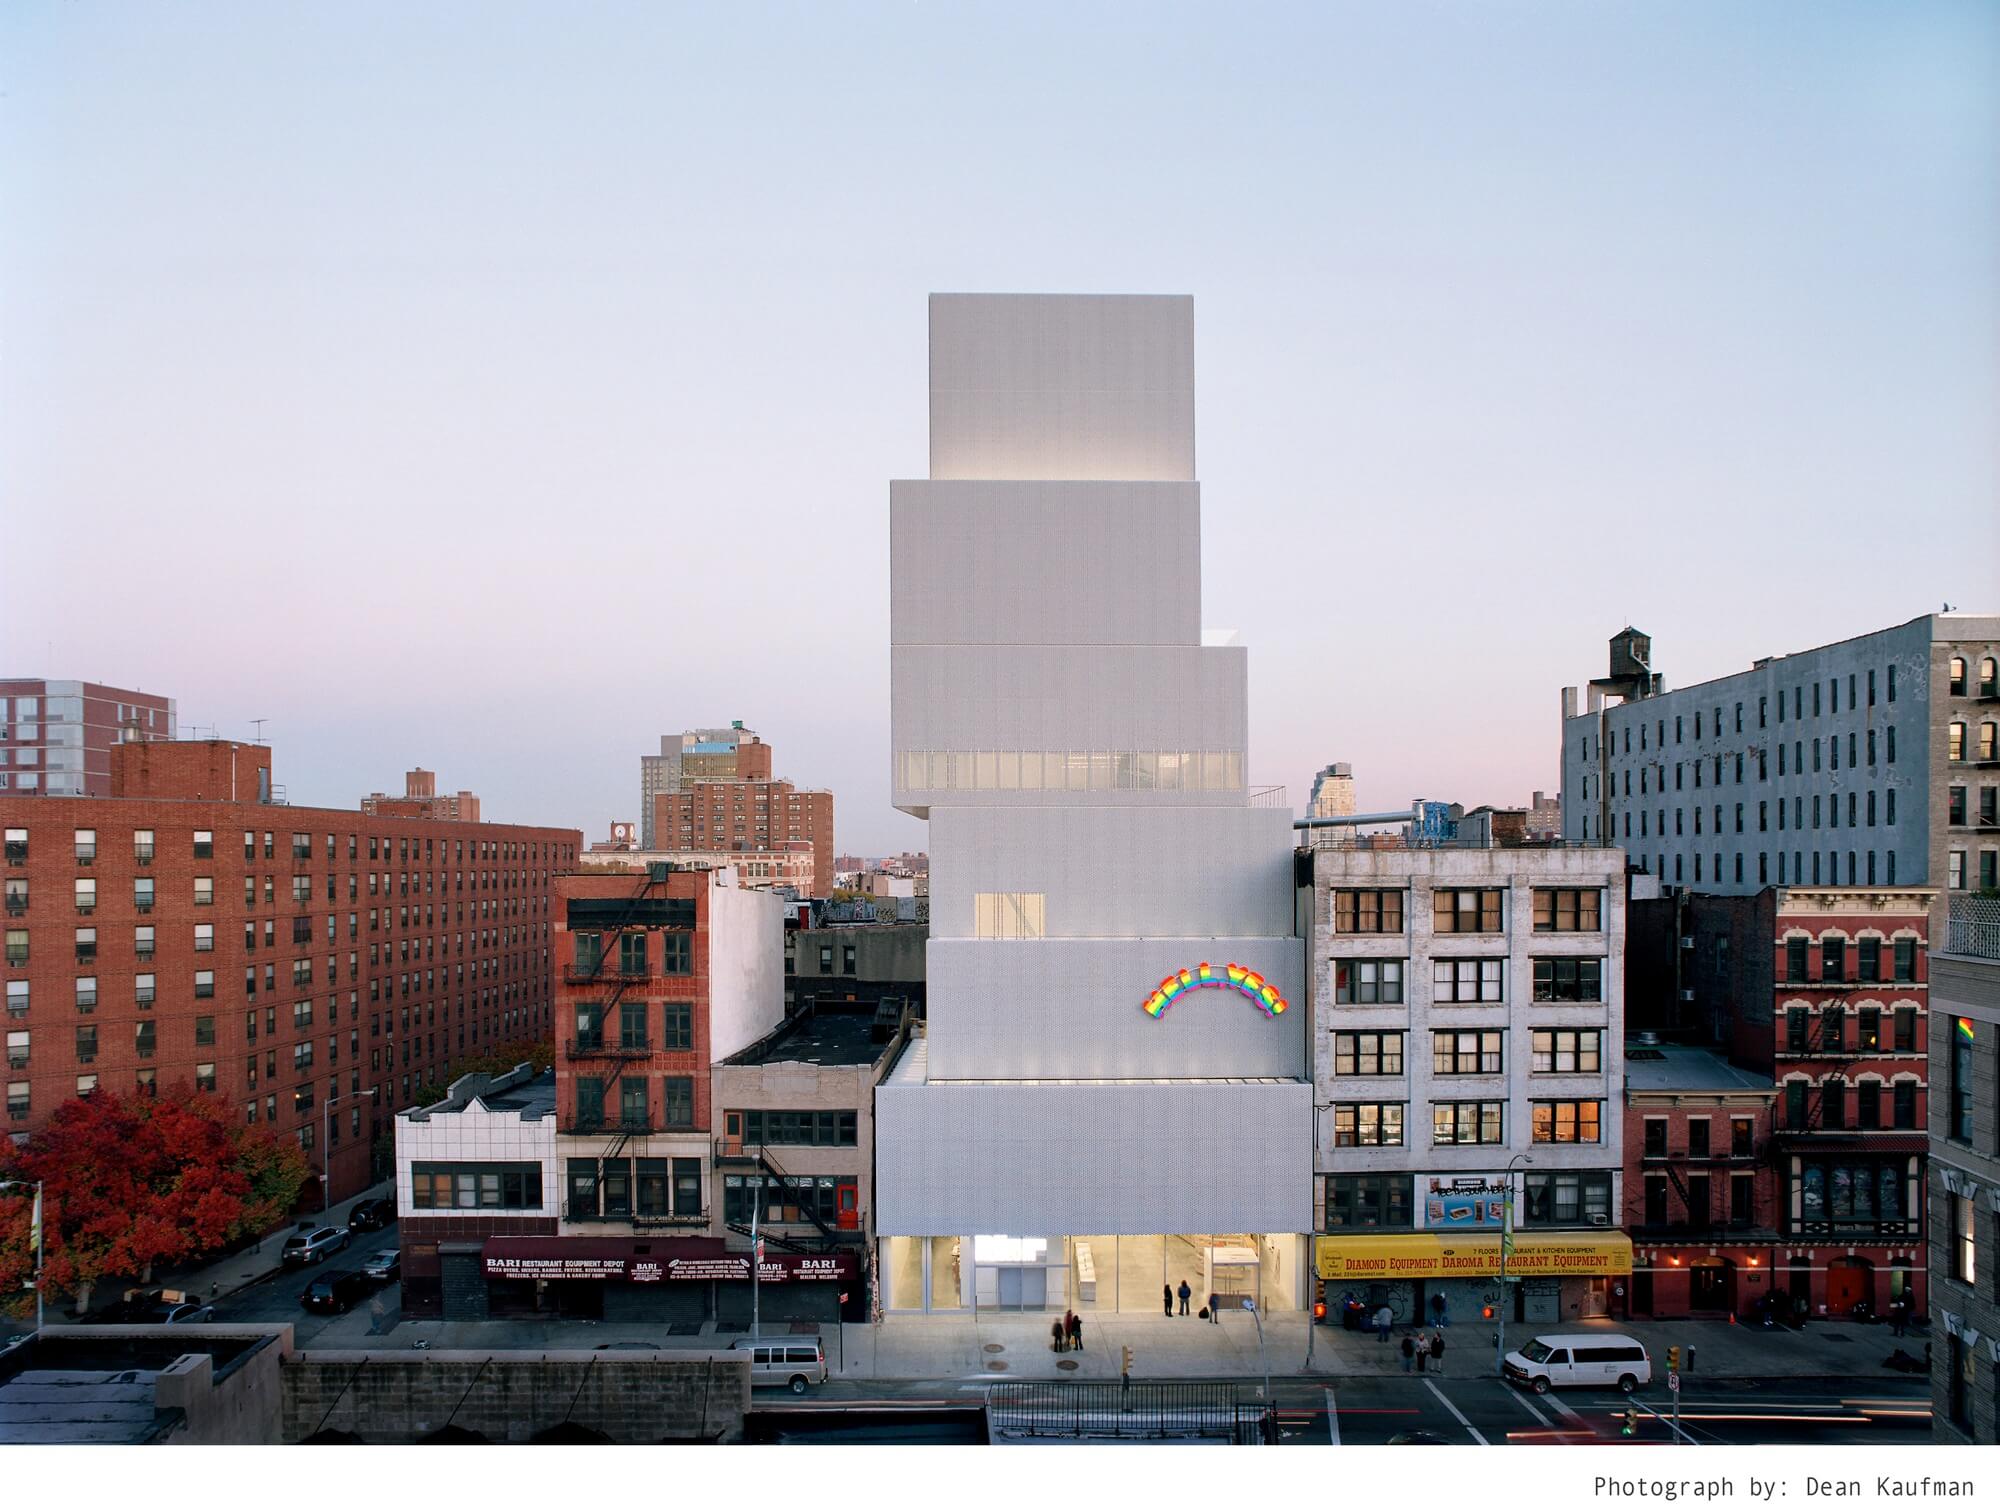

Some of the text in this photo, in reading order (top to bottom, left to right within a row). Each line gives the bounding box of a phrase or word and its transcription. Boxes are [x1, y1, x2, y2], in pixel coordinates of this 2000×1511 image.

[486, 1259, 520, 1267] BARI
[801, 1260, 836, 1268] BARI
[1346, 1259, 1386, 1270] DIAMOND
[1390, 1258, 1438, 1270] EQUIPMENT
[1442, 1257, 1484, 1268] DAROMA
[1488, 1256, 1549, 1267] RETAURANT
[1553, 1255, 1609, 1267] EQUIPMENT
